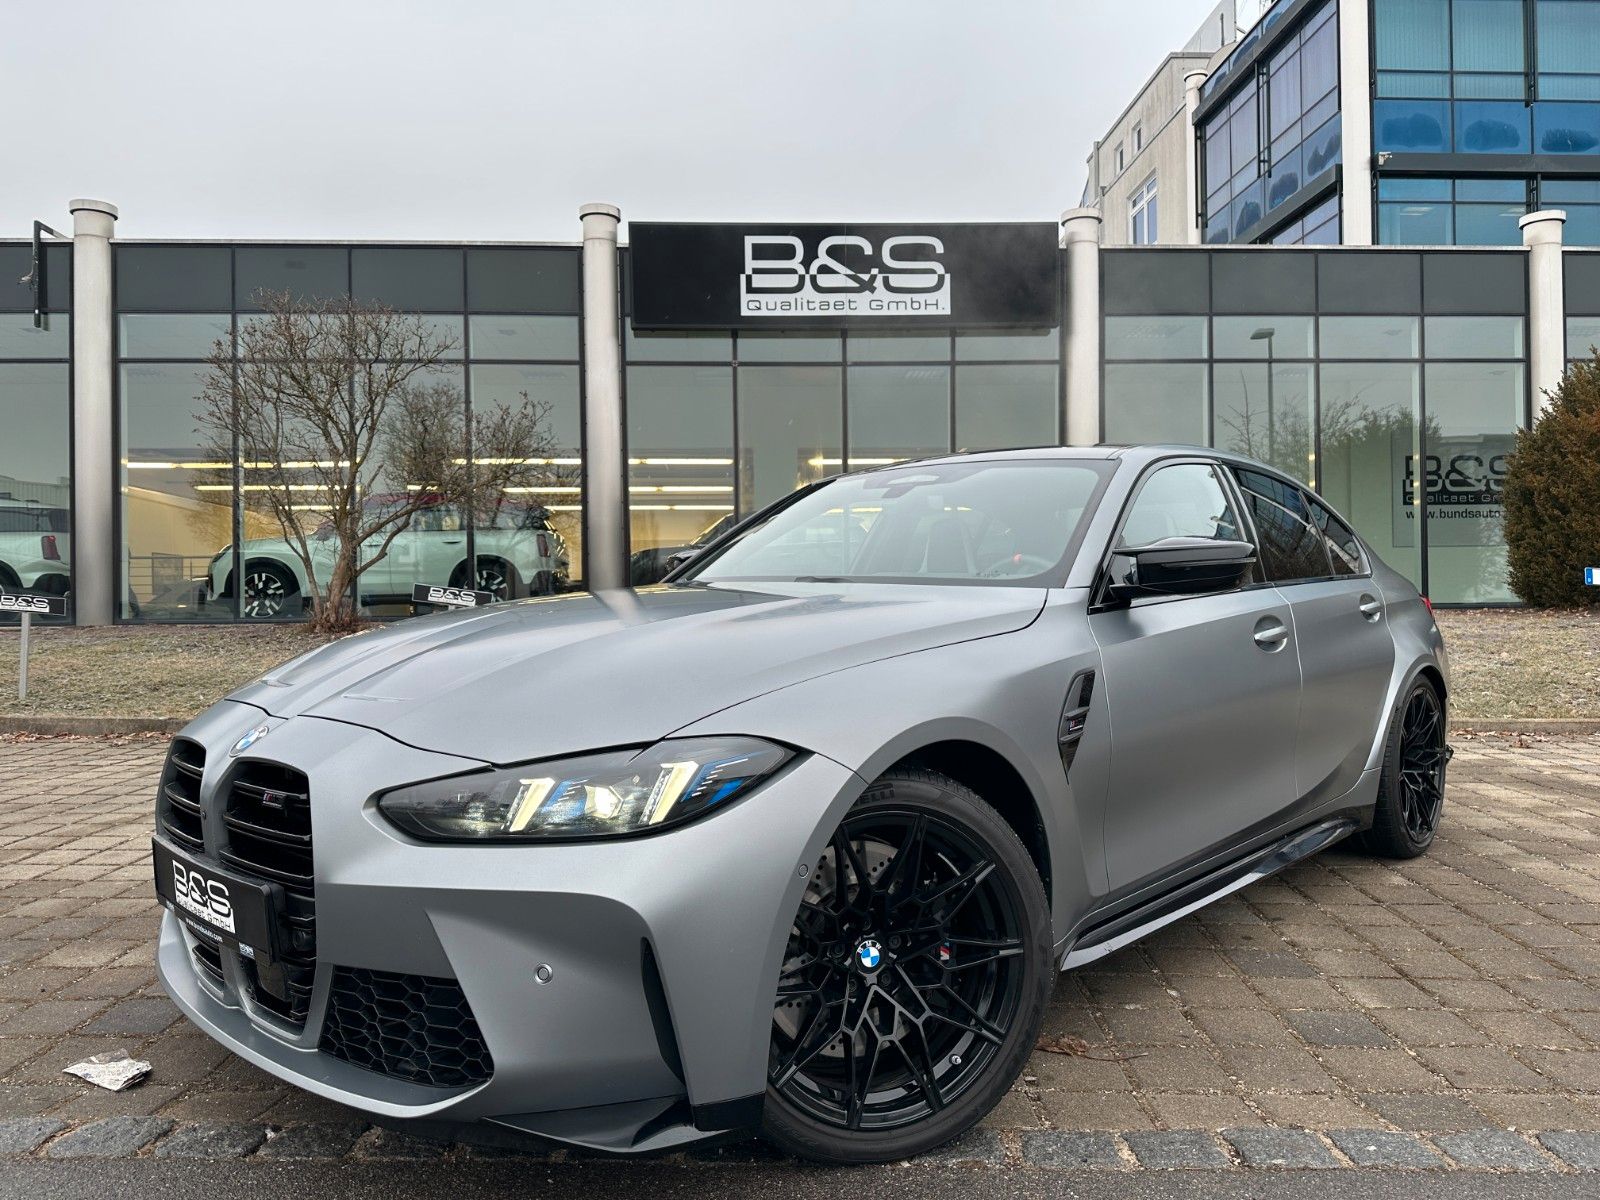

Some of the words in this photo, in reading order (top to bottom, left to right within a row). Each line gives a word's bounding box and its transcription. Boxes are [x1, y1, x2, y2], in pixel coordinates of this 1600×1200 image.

[744, 235, 945, 295] B&S
[747, 299, 857, 311] Qualitaet
[868, 298, 946, 311] GmbH.
[0, 595, 49, 608] B&S
[429, 587, 476, 603] B&S
[173, 860, 231, 918] B&S
